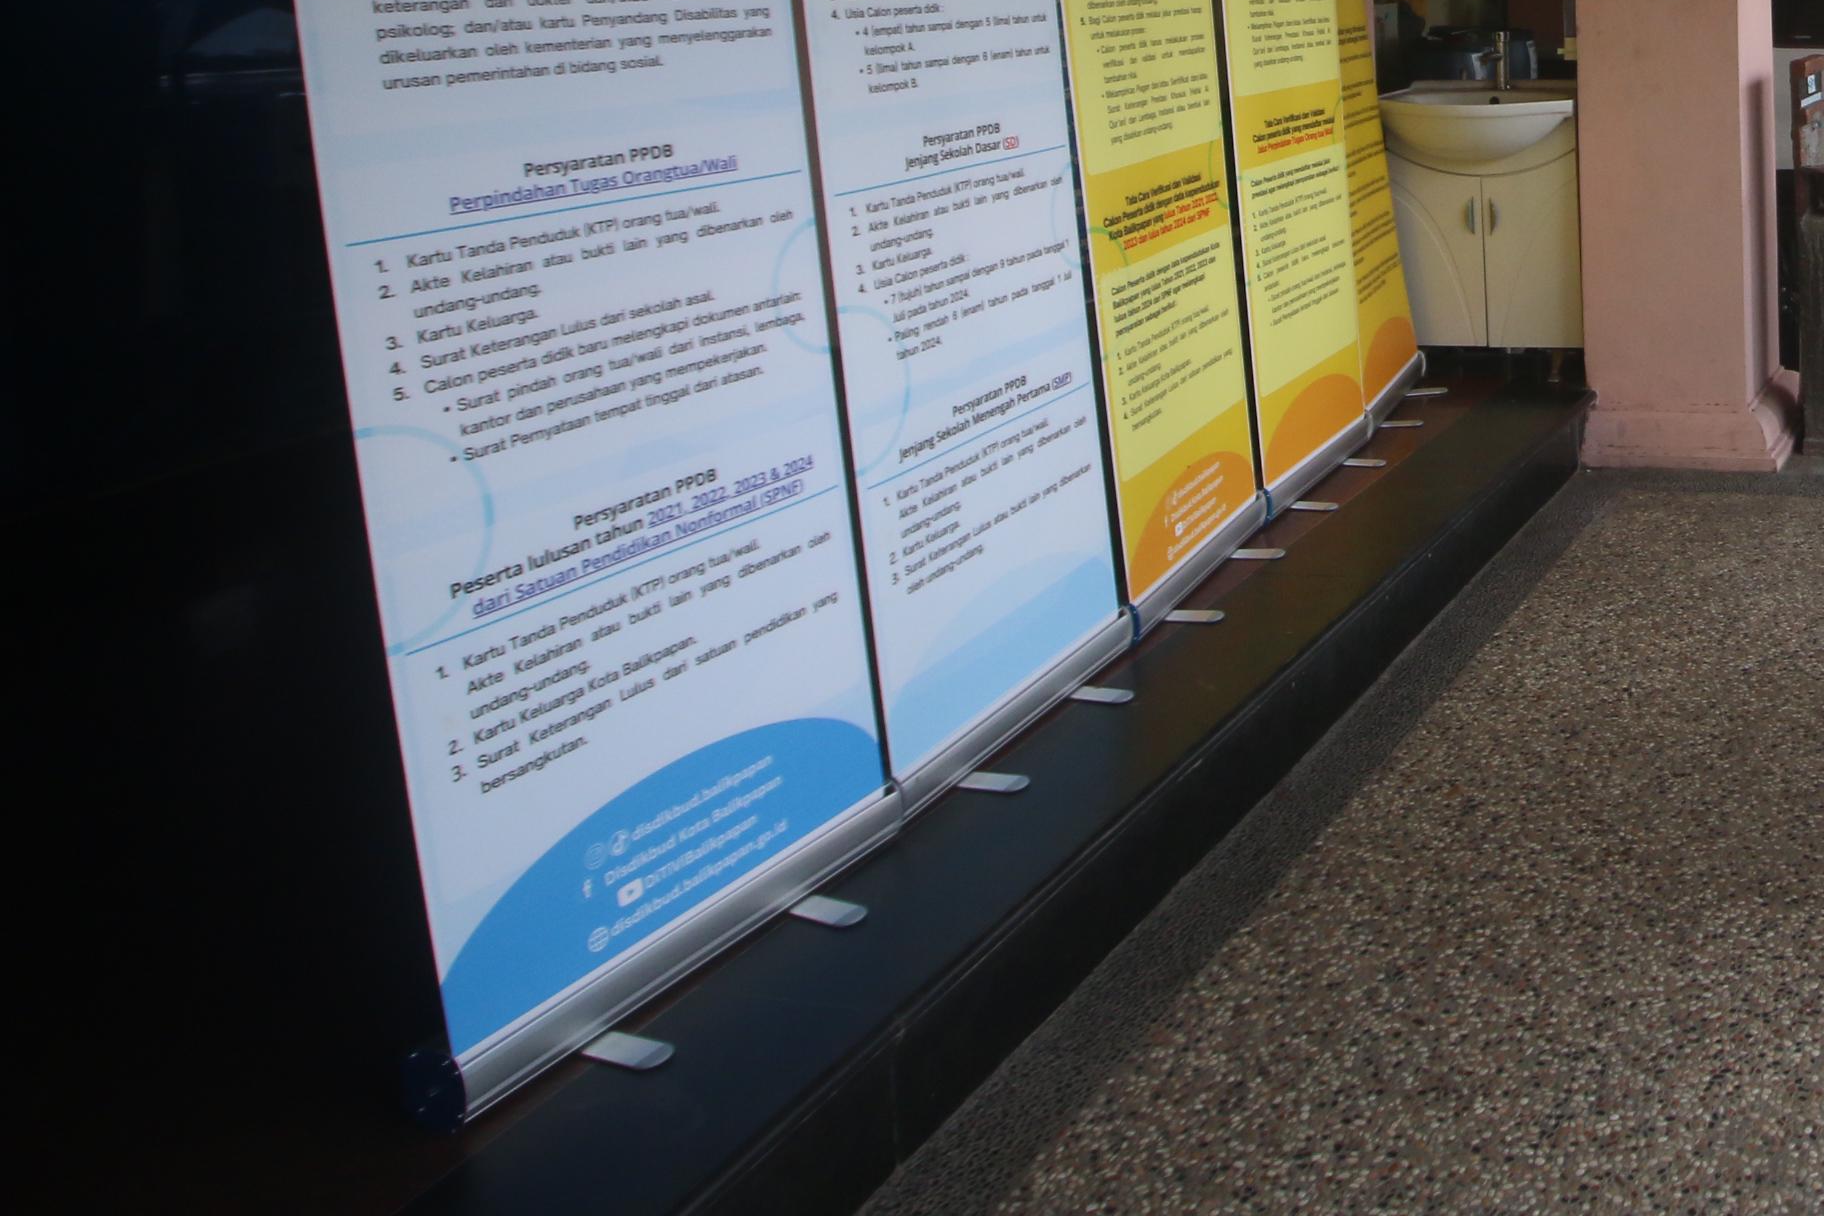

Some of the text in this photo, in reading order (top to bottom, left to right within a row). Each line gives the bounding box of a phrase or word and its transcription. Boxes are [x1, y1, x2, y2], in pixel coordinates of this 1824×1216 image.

[522, 143, 674, 176] Persyaratan PPDB
[904, 152, 939, 171] Jenjang
[938, 144, 974, 161] Sekolah
[973, 140, 1001, 154] Dasar
[921, 122, 1001, 147] Persyaratan PPDB
[448, 155, 738, 215] Perpindahan Tugas Orangtua/Wali
[419, 347, 467, 369] Surat
[469, 328, 557, 356] Keterangan
[560, 318, 597, 336] Lulus
[599, 309, 626, 326] dari
[628, 298, 682, 319] sekolah
[898, 435, 936, 463] Jenjang
[935, 418, 971, 443] Sekolah
[970, 397, 1016, 424] Menengah
[1015, 382, 1051, 404] Pertama
[951, 374, 1027, 416] Persyaratan PPDB
[449, 454, 814, 598] Peserta lulusan tahun 2021, 2022, 2023 & 2024
[572, 468, 717, 529] Persyaratan PPDB
[471, 479, 804, 618] dari Satuan Pendidikan Nonformal (SPNF)
[472, 718, 516, 744] Kartu
[518, 687, 585, 723] Keluarga
[586, 670, 620, 692] Kota
